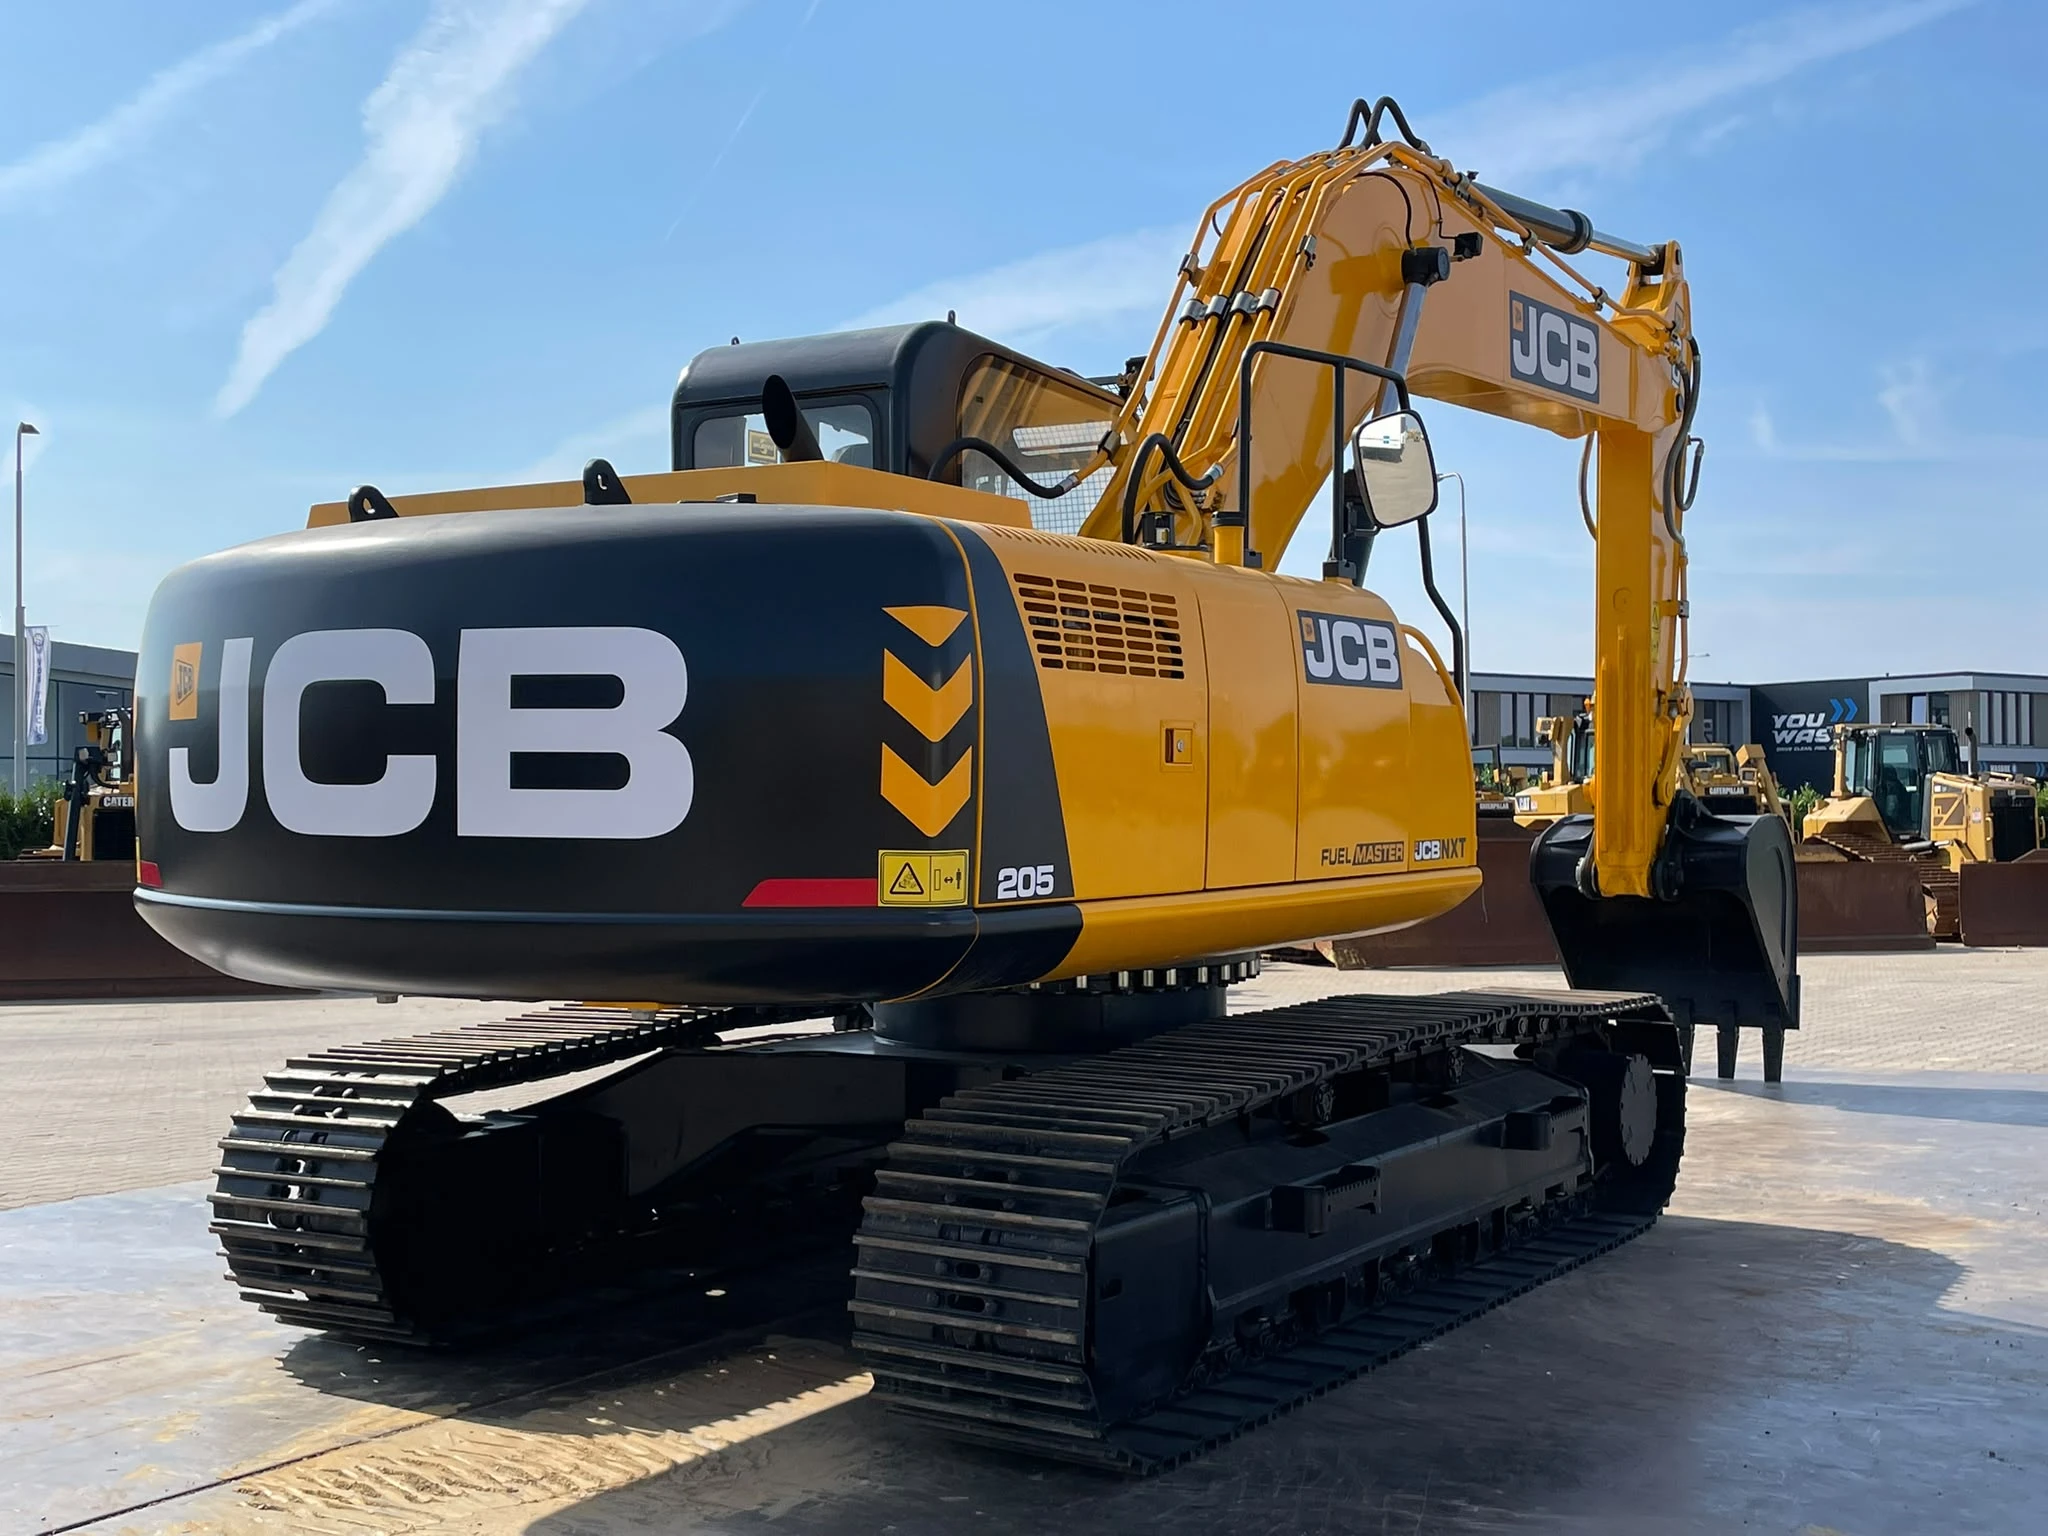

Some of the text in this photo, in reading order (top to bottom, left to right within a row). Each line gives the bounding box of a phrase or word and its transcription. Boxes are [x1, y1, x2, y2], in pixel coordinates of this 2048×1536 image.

[1513, 306, 1598, 394] JCB
[1305, 619, 1399, 682] JCB
[169, 627, 694, 839] JCB
[1772, 713, 1825, 728] YOU
[1519, 797, 1530, 810] CAT
[1321, 843, 1403, 866] FUEL MASTER
[997, 865, 1055, 900] 205
